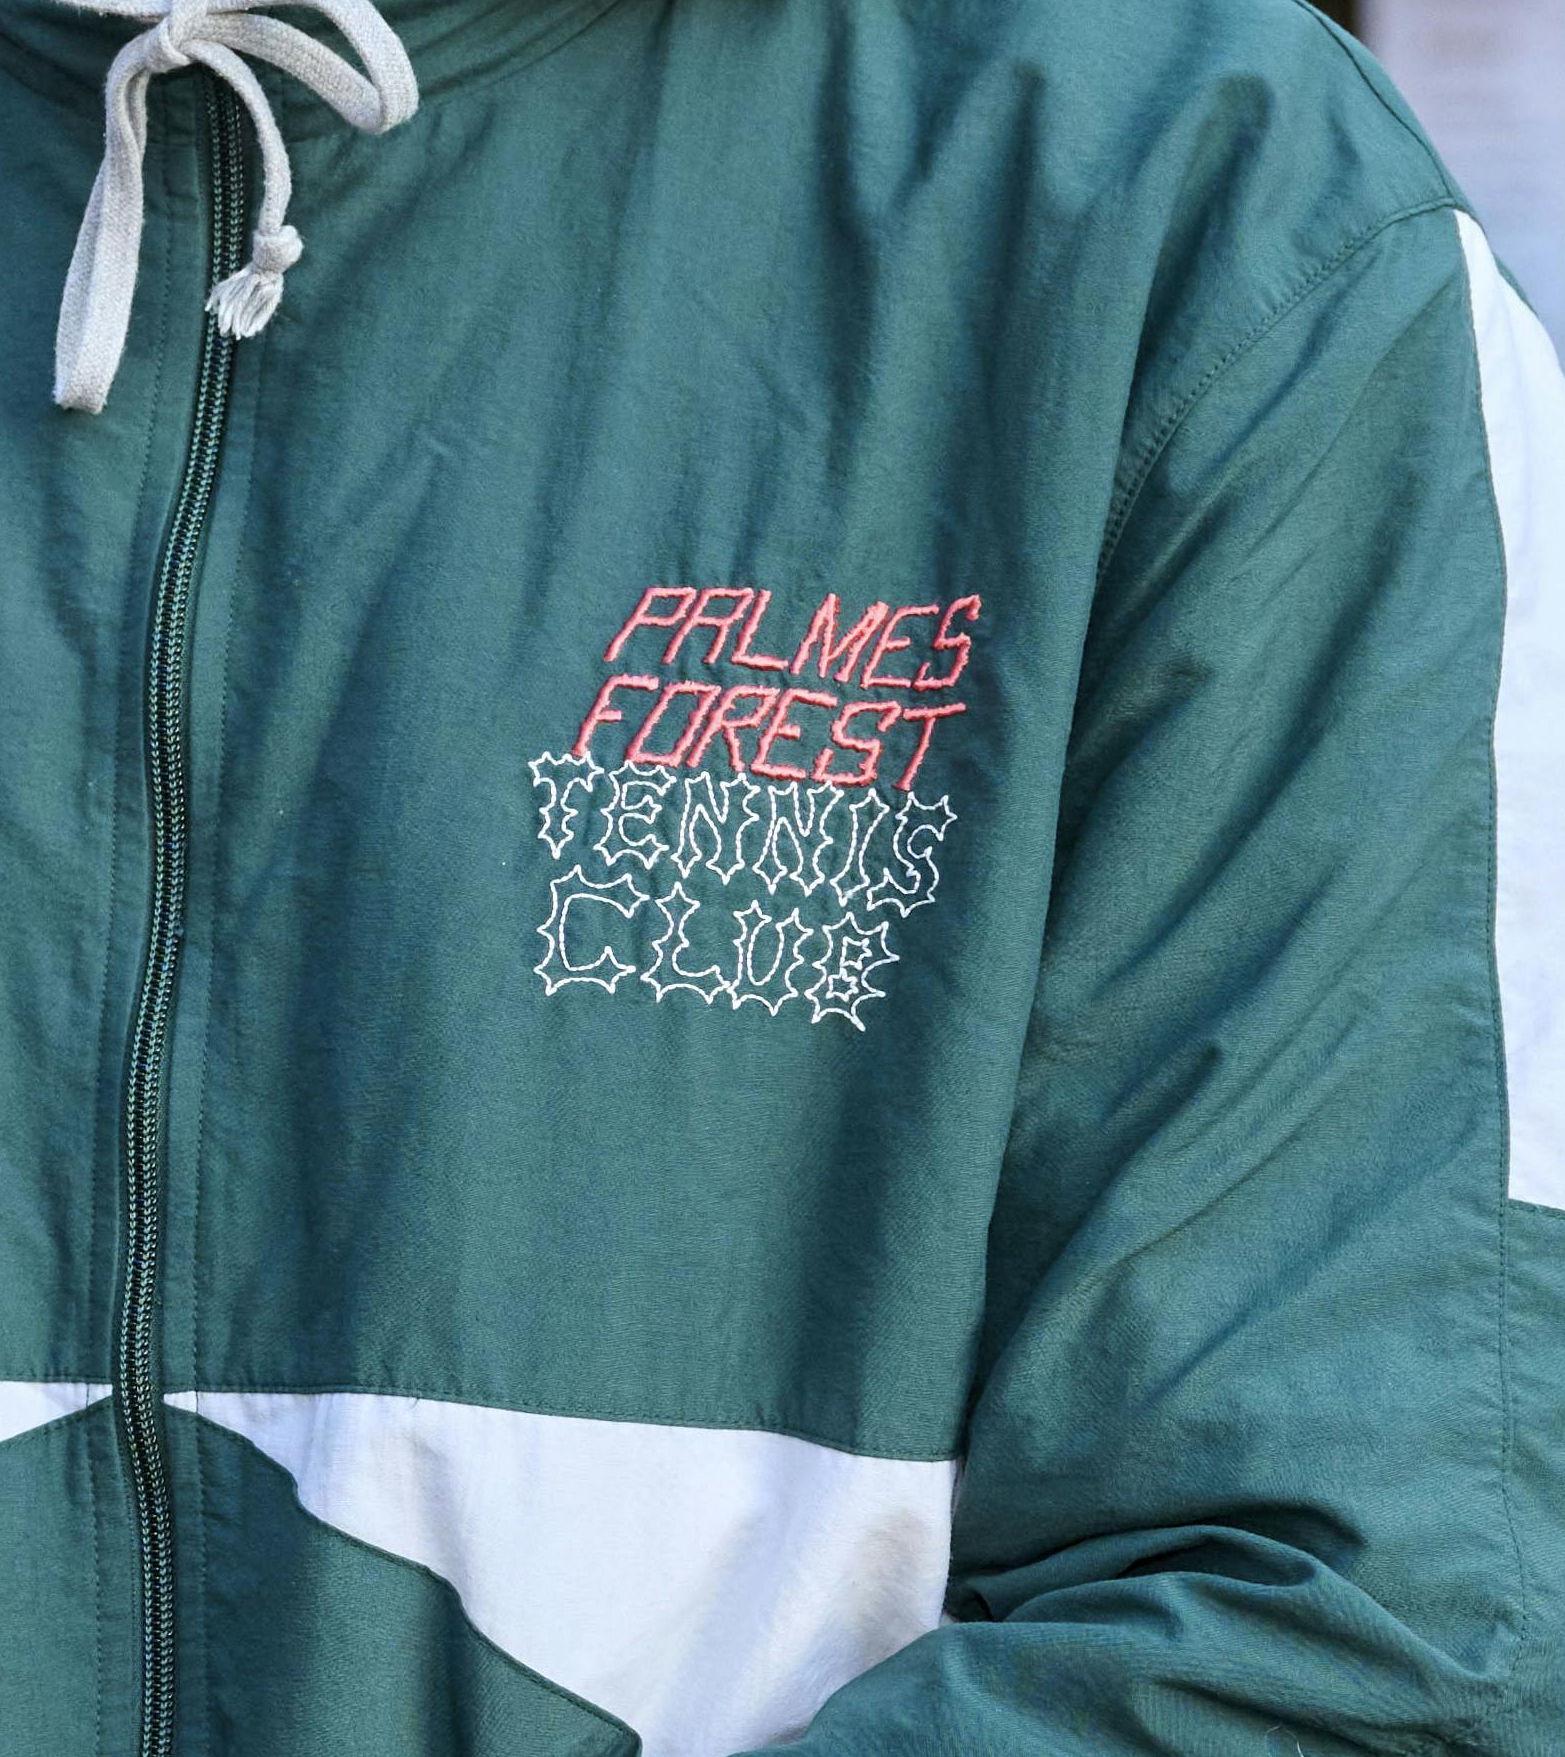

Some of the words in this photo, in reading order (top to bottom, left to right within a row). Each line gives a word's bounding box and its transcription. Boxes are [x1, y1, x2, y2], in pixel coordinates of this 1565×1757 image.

[603, 586, 982, 692] PALMES
[571, 673, 967, 791] FOREST
[527, 750, 959, 918] TENNIS
[532, 864, 901, 1033] CLUB
